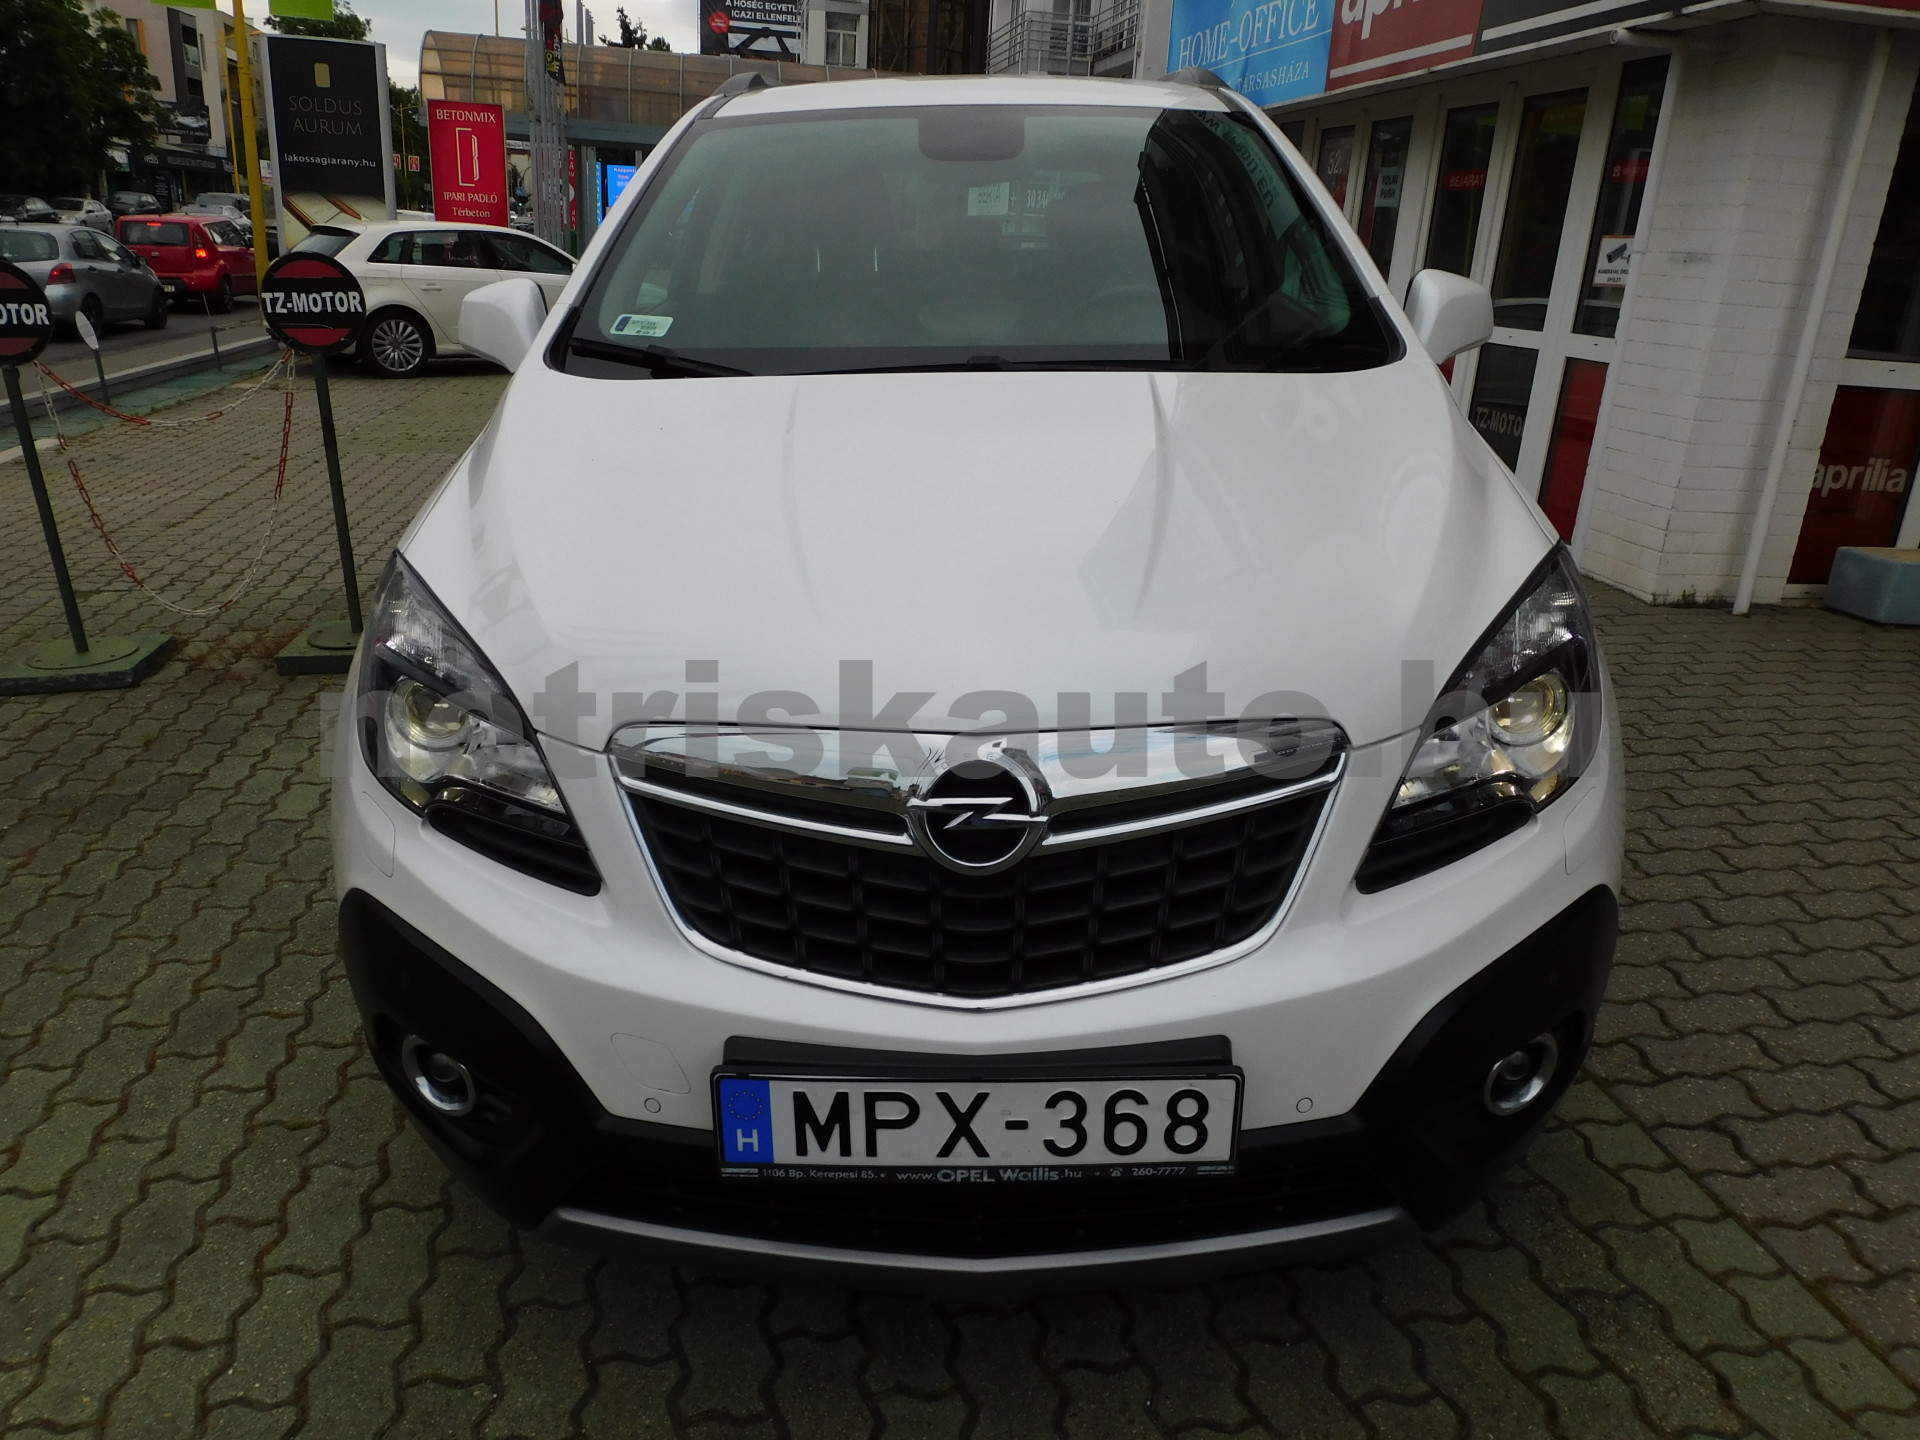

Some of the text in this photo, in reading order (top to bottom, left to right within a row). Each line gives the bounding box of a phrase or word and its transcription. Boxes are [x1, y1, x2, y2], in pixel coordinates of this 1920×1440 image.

[732, 10, 755, 19] IGAZI
[288, 95, 363, 116] SOLDUS
[436, 109, 496, 124] BETONMIX
[292, 117, 363, 136] AURUM
[284, 152, 377, 168] lakossagiarany.hu
[443, 191, 498, 204] IPARI PADLÓ
[452, 207, 491, 218] Térbeton
[262, 292, 363, 313] TZ-MOTOR
[1814, 457, 1908, 498] aprilia
[736, 1089, 1209, 1158] H MPX-368
[809, 1170, 858, 1179] Kerepesi
[1000, 1167, 1082, 1182] Wallis.hu
